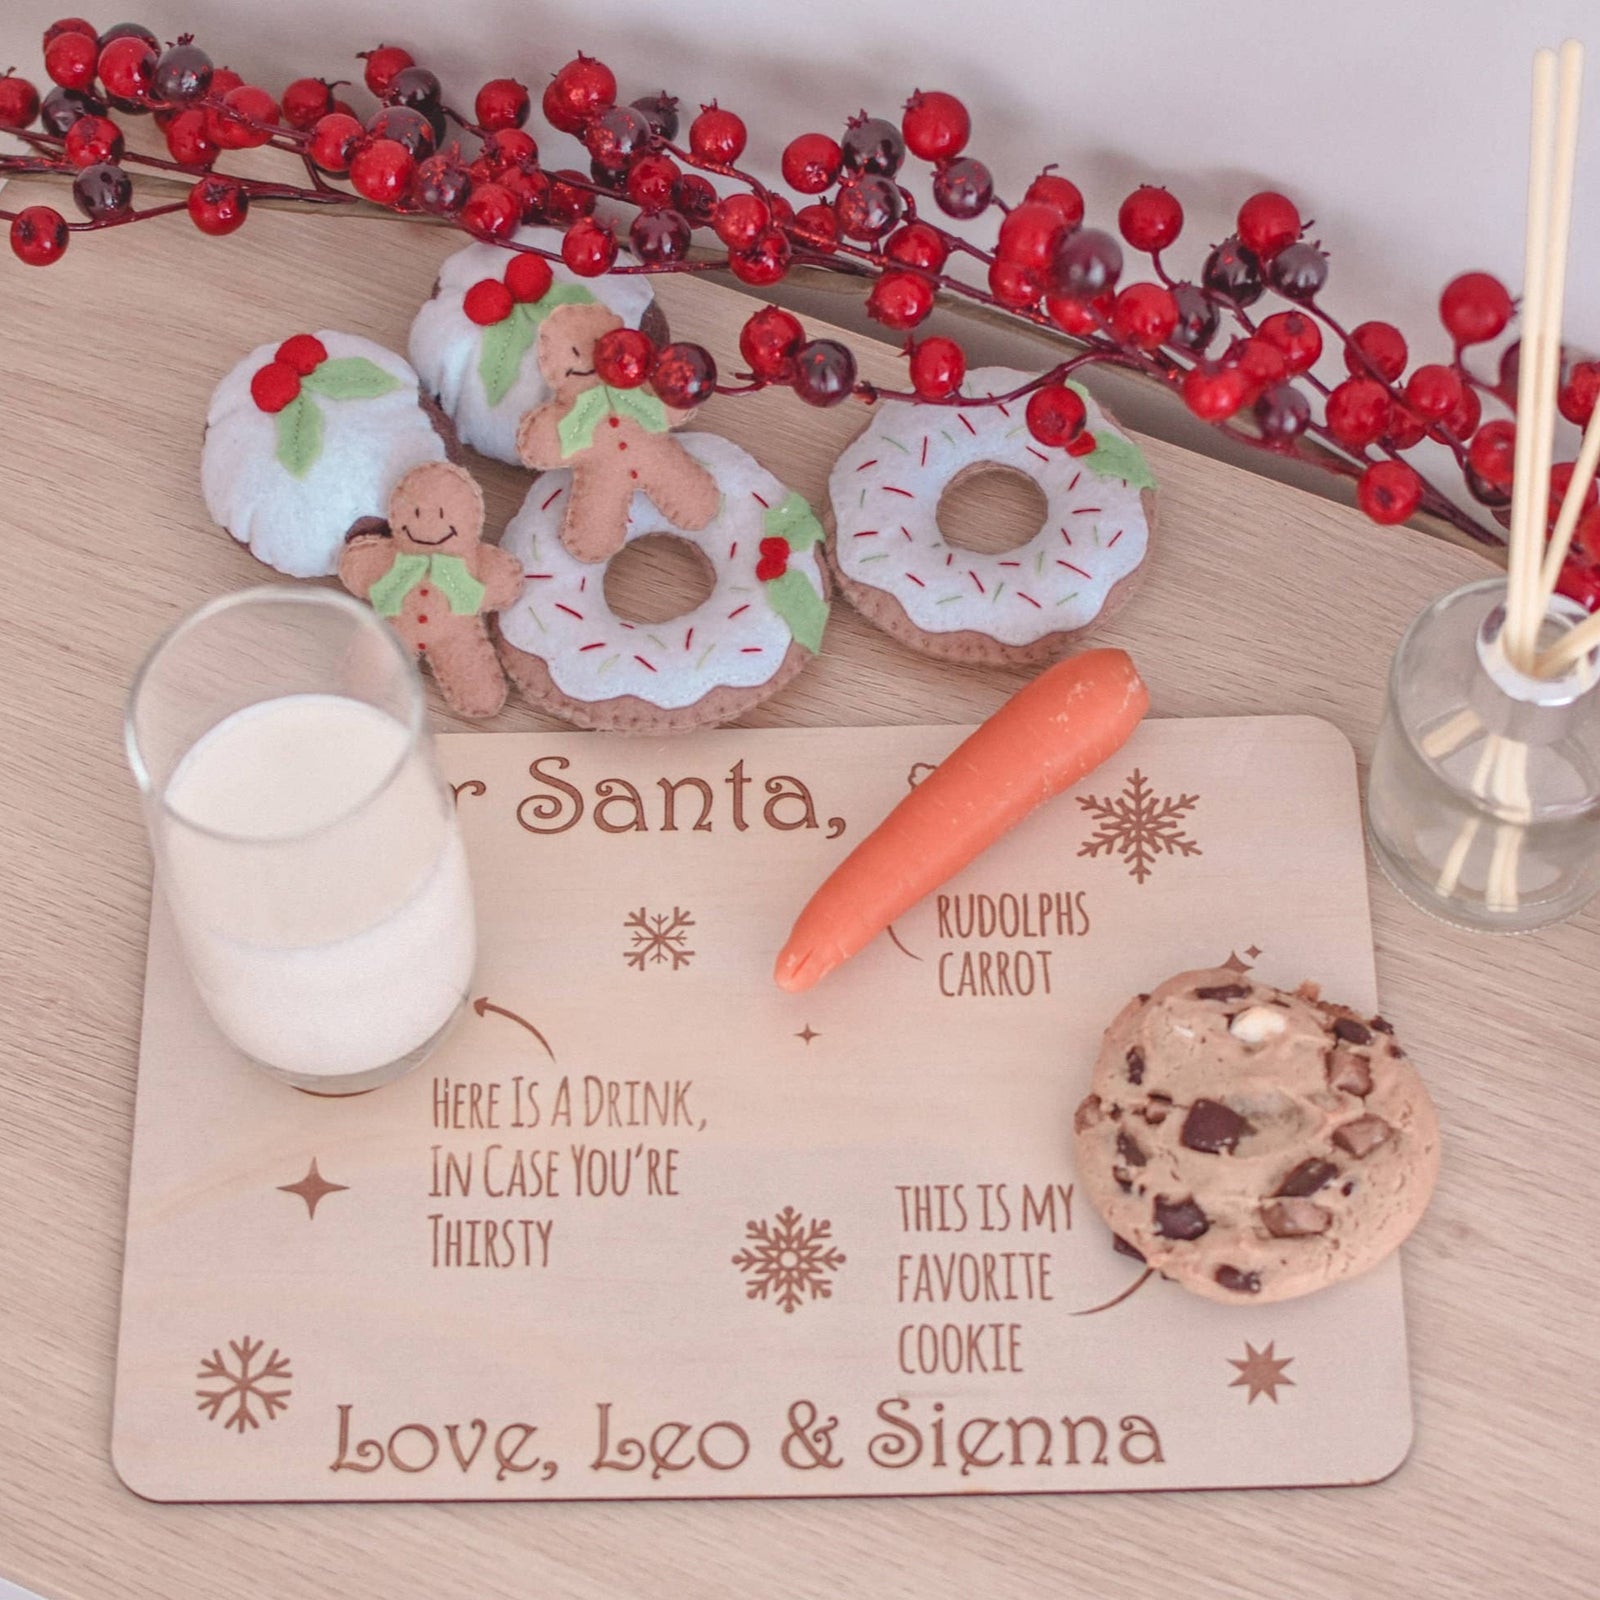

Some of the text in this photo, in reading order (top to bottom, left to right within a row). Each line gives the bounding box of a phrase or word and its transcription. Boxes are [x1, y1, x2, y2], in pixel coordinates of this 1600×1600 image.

[516, 755, 847, 840] Santa,
[937, 890, 1090, 939] RUDOLPHS
[938, 950, 1053, 998] CARROT
[550, 1074, 572, 1128] A
[894, 1182, 1074, 1234] THIS IS MY
[897, 1251, 1055, 1303] FAVORITE
[898, 1322, 1024, 1375] COOKIE
[328, 1395, 1166, 1482] Love, Leo & Sienna
